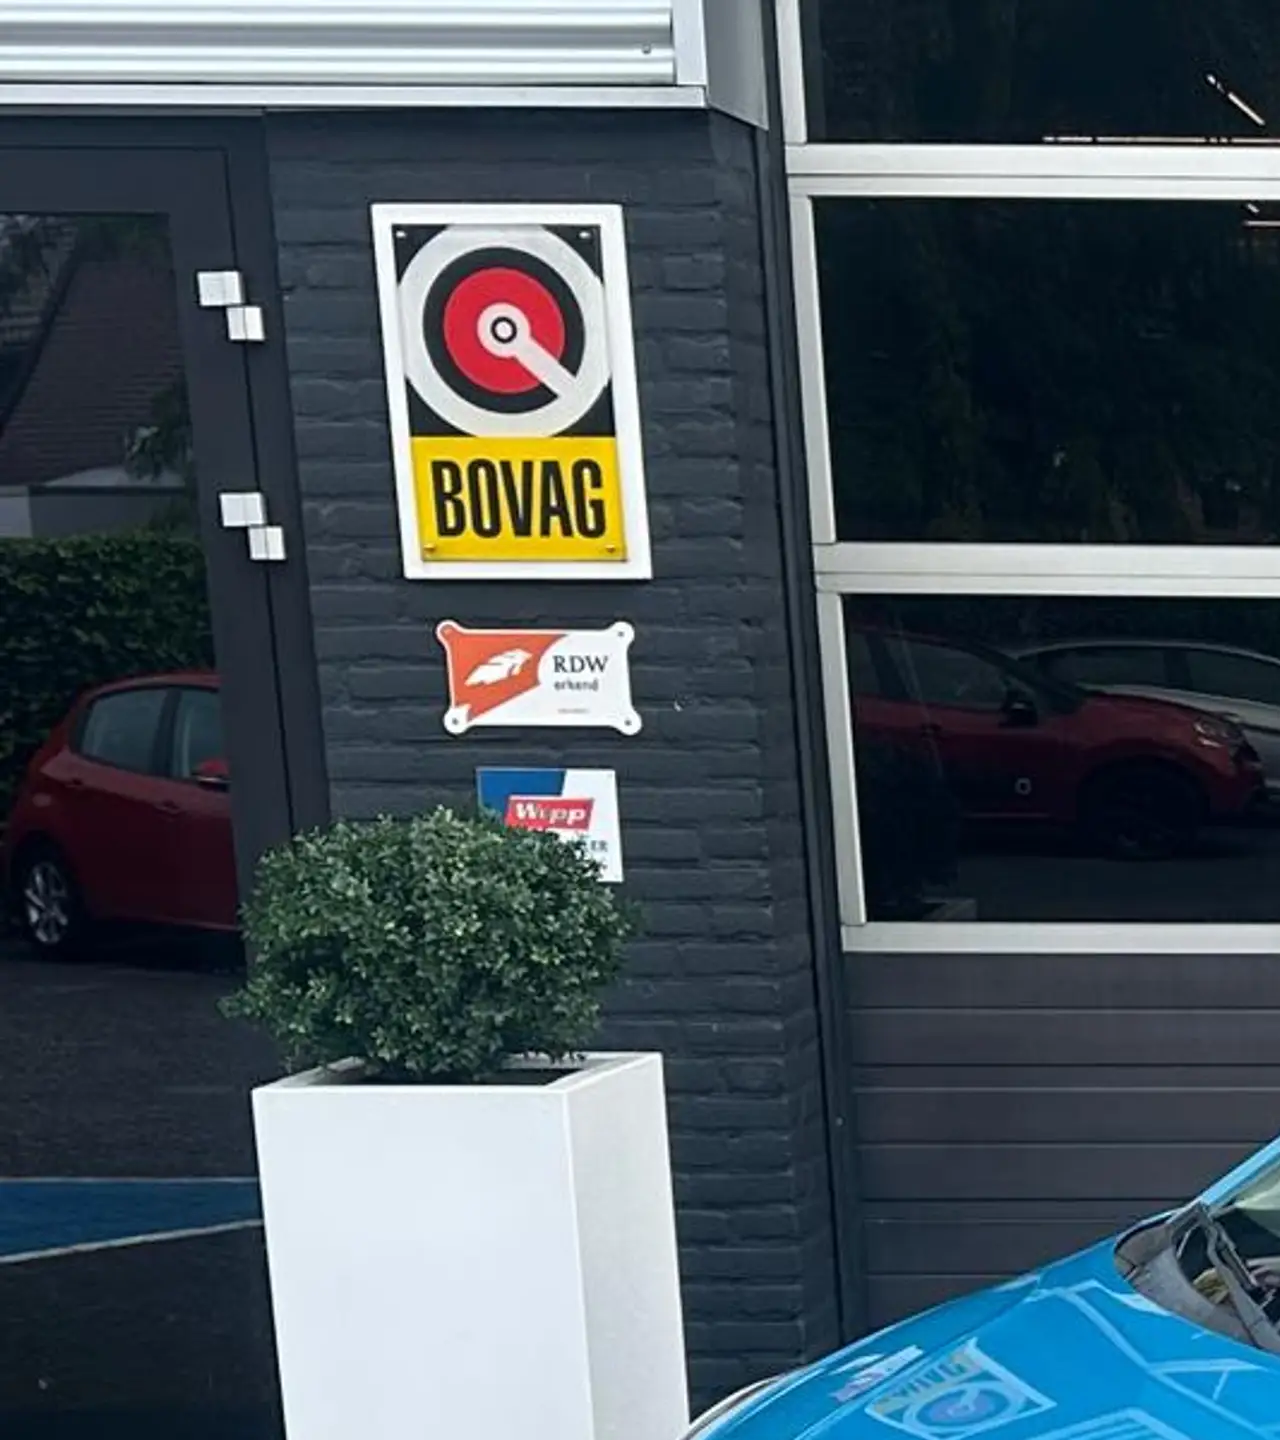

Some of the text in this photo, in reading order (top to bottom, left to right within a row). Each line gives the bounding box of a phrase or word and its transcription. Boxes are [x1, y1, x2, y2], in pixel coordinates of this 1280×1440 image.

[431, 459, 606, 538] BOVAG
[553, 655, 609, 673] RDW
[554, 678, 599, 692] erkend
